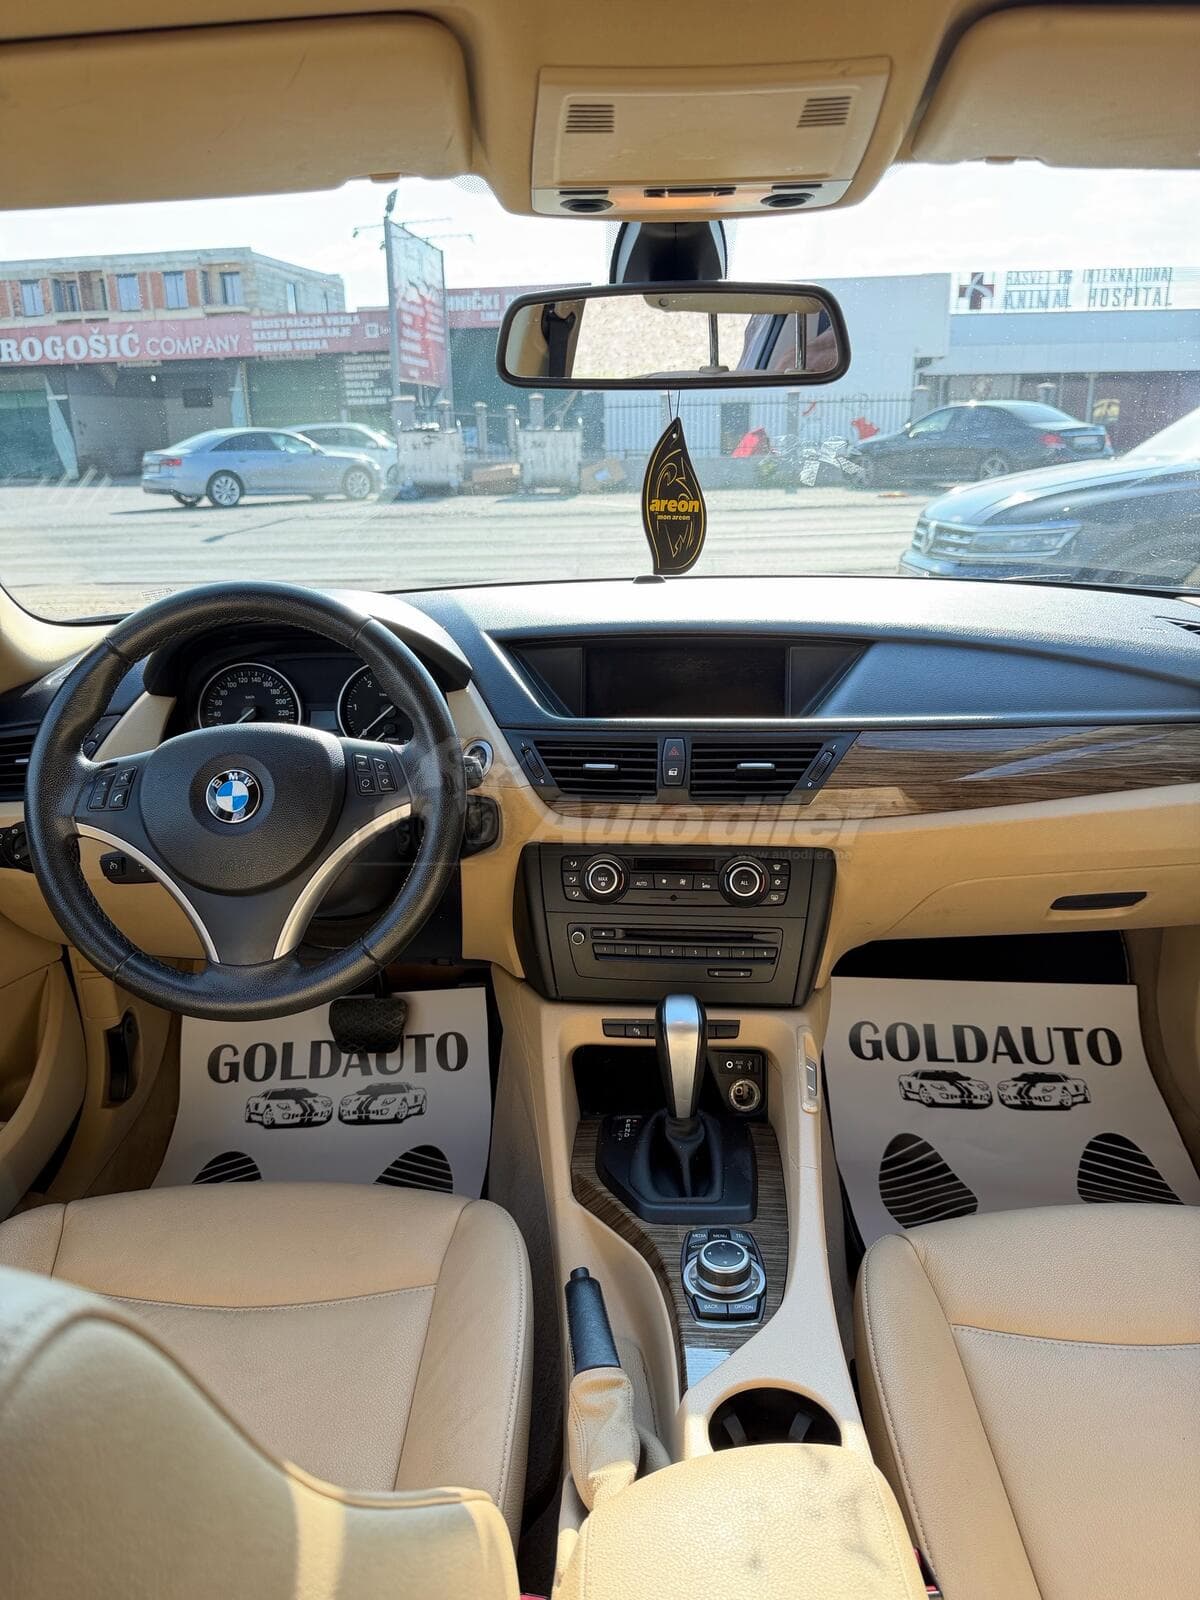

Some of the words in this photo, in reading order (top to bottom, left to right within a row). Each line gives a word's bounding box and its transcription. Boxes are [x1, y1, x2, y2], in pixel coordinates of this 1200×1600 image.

[1082, 267, 1173, 283] INTERNATIONAL
[1004, 289, 1071, 309] ANIMAL
[1087, 286, 1173, 307] HOSPITAL
[0, 325, 140, 362] ROGOŠIĆ
[146, 334, 240, 358] COMPANY
[650, 499, 700, 513] areon
[212, 772, 254, 788] BMW
[848, 1020, 1123, 1066] GOLDAUTO
[207, 1031, 469, 1084] GOLDAUTO
